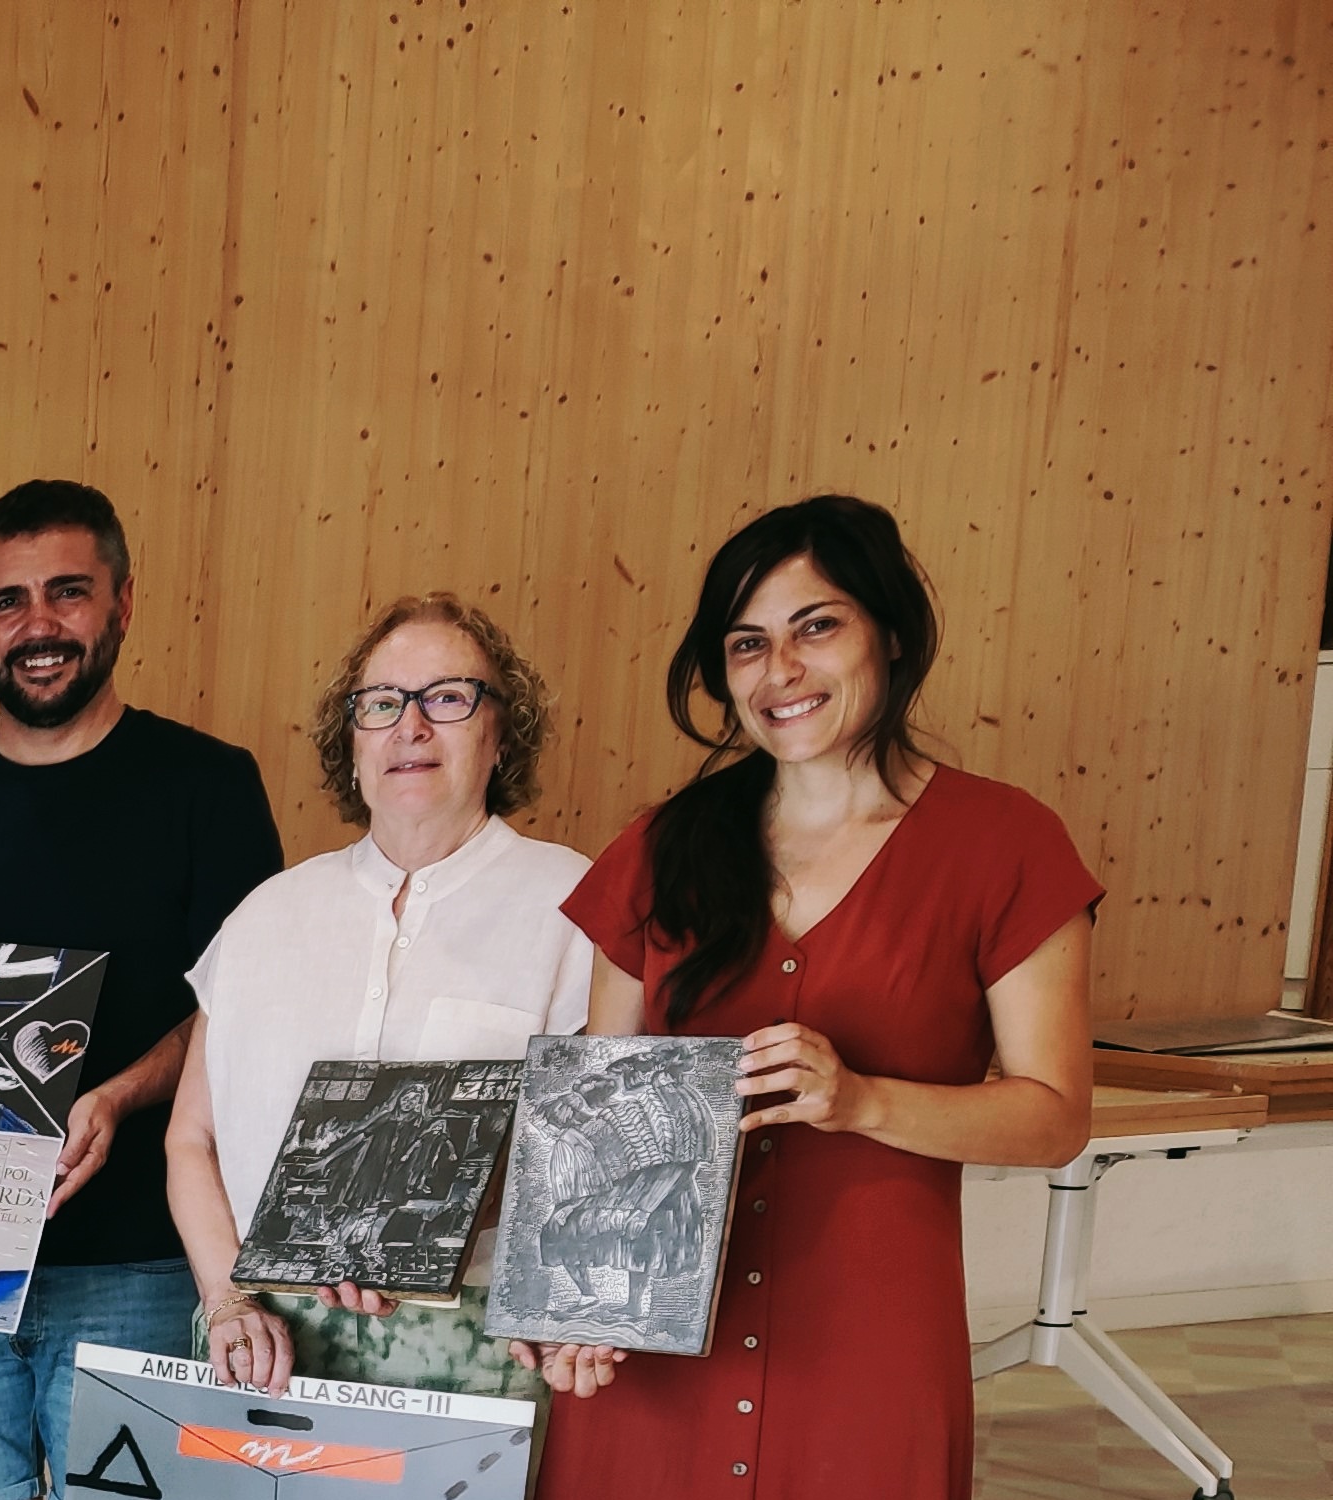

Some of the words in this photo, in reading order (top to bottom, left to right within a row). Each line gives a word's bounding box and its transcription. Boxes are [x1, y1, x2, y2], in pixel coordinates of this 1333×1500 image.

[4, 1167, 33, 1182] POL
[141, 1357, 189, 1381] AMB
[300, 1380, 330, 1402] LA
[336, 1384, 407, 1410] SANG
